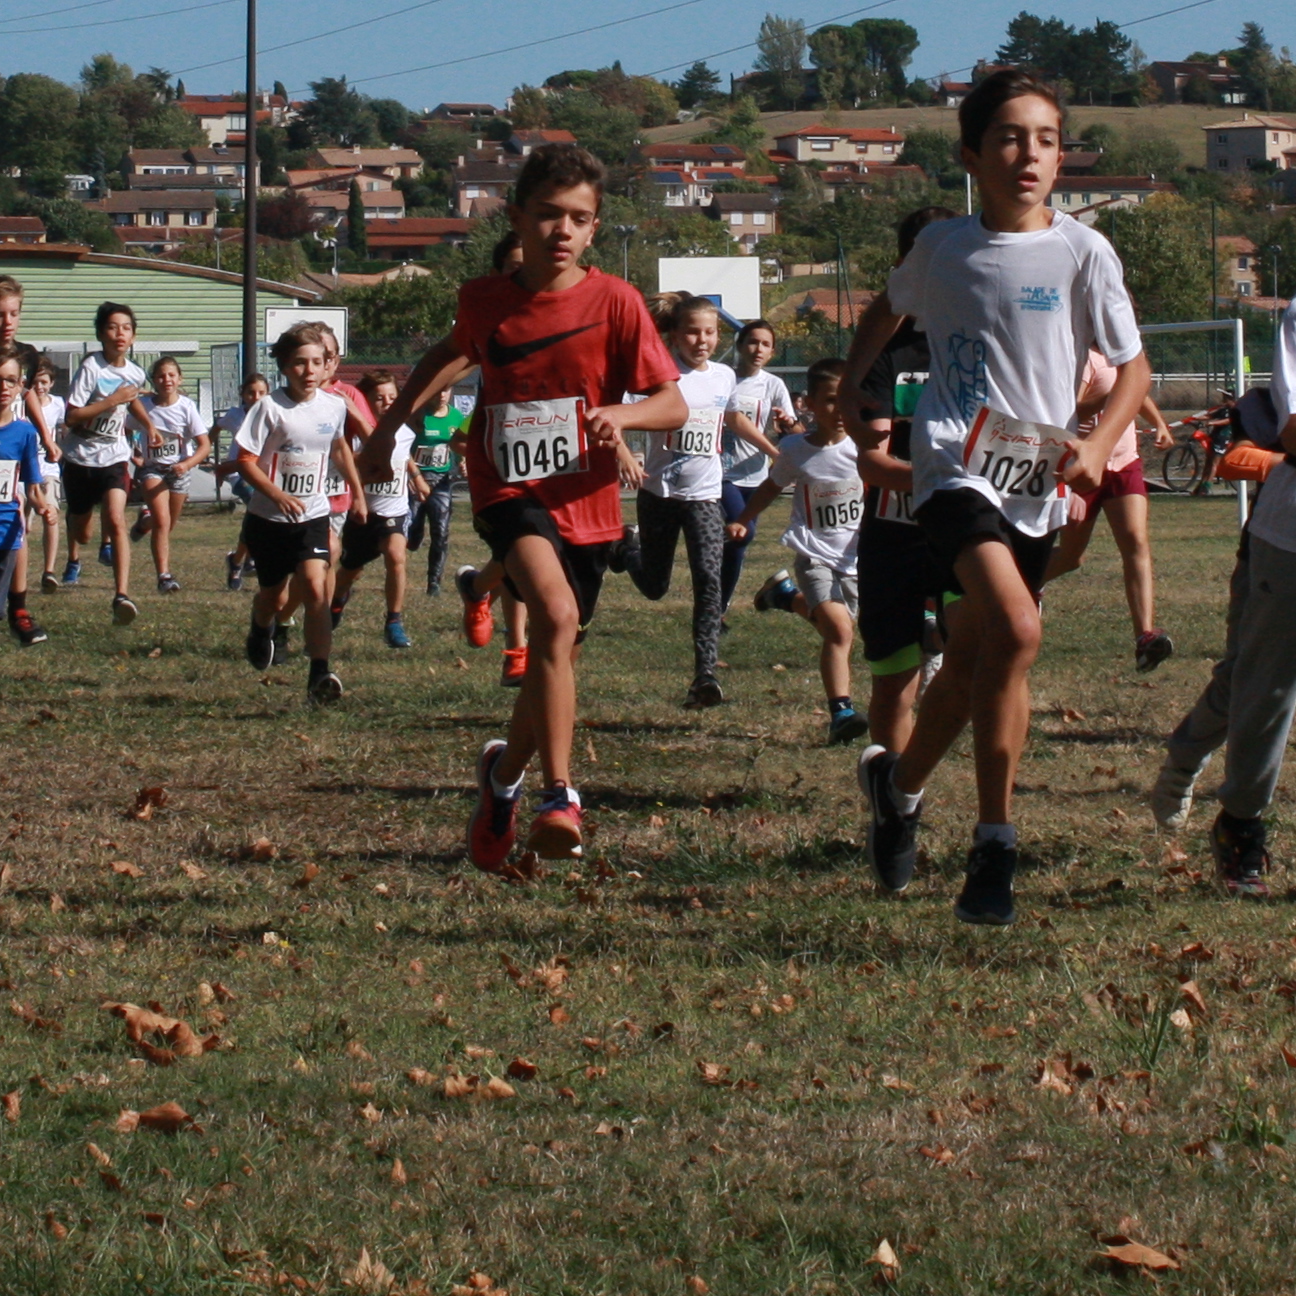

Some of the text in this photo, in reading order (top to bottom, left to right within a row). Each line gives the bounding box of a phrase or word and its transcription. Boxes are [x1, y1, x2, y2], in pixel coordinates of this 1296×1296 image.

[677, 430, 712, 453] 1033
[498, 435, 569, 478] 1046
[281, 473, 314, 494] 1019
[979, 450, 1049, 498] 1028
[815, 499, 860, 528] 1056
